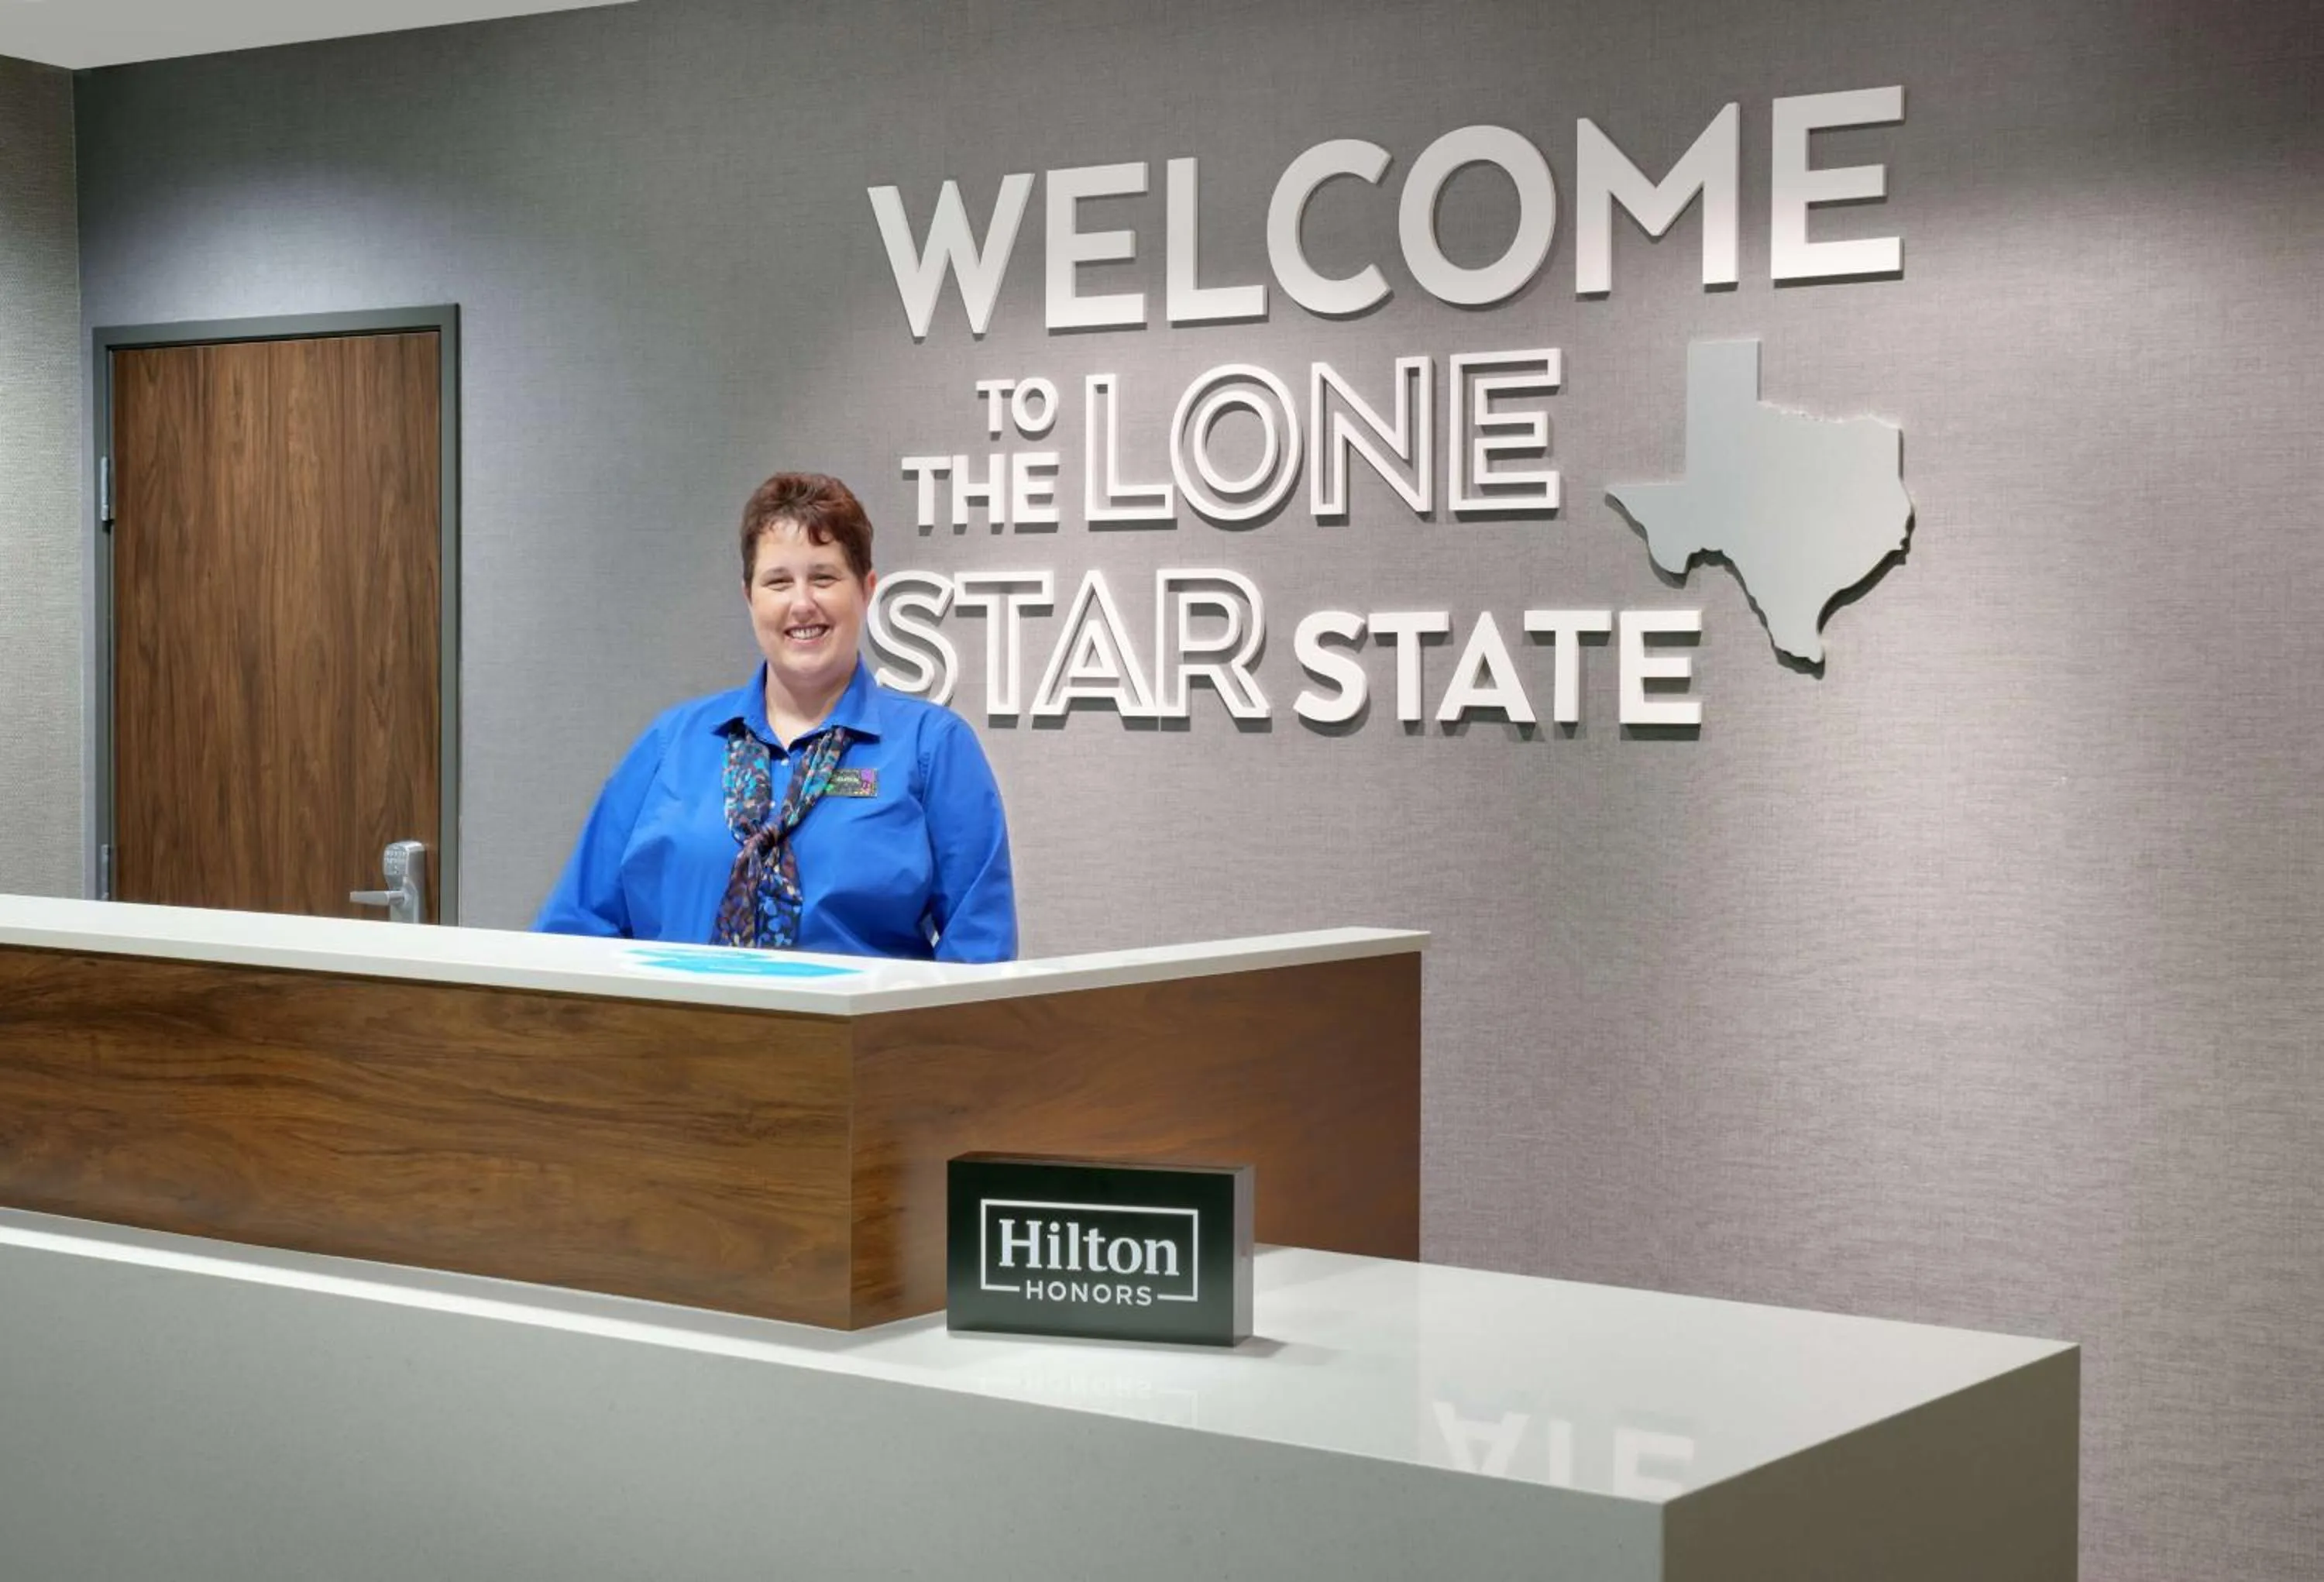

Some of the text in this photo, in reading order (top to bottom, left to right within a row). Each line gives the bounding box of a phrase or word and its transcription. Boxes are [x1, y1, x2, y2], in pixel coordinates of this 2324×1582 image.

[867, 84, 1905, 339] WELCOME
[901, 348, 1561, 526] THE LONE
[975, 377, 1059, 433] TO
[867, 568, 1703, 725] STAR STATE
[998, 1218, 1181, 1277] Hilton
[1026, 1279, 1153, 1306] HONORS
